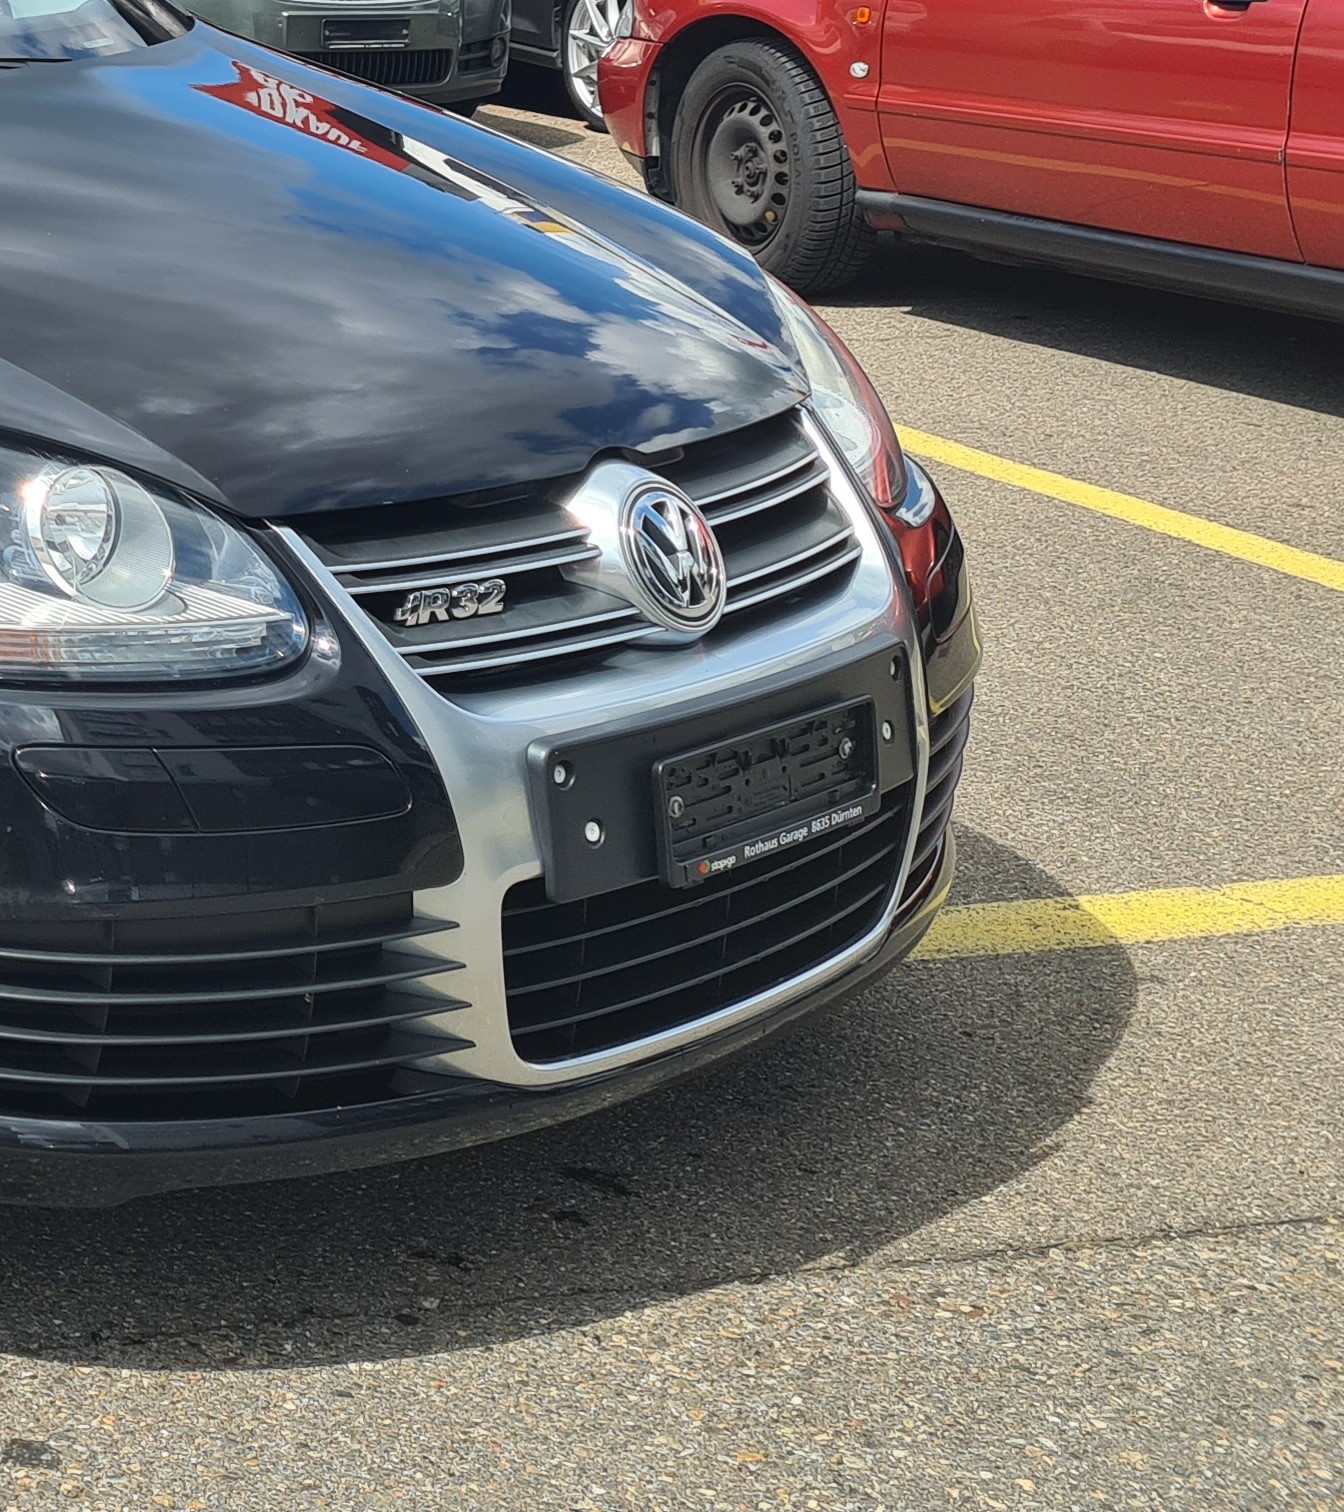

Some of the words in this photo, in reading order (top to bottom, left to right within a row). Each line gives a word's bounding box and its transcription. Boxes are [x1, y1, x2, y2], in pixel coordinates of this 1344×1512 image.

[398, 578, 507, 626] R32
[744, 838, 779, 859] Rothaus
[779, 825, 809, 846] Garage
